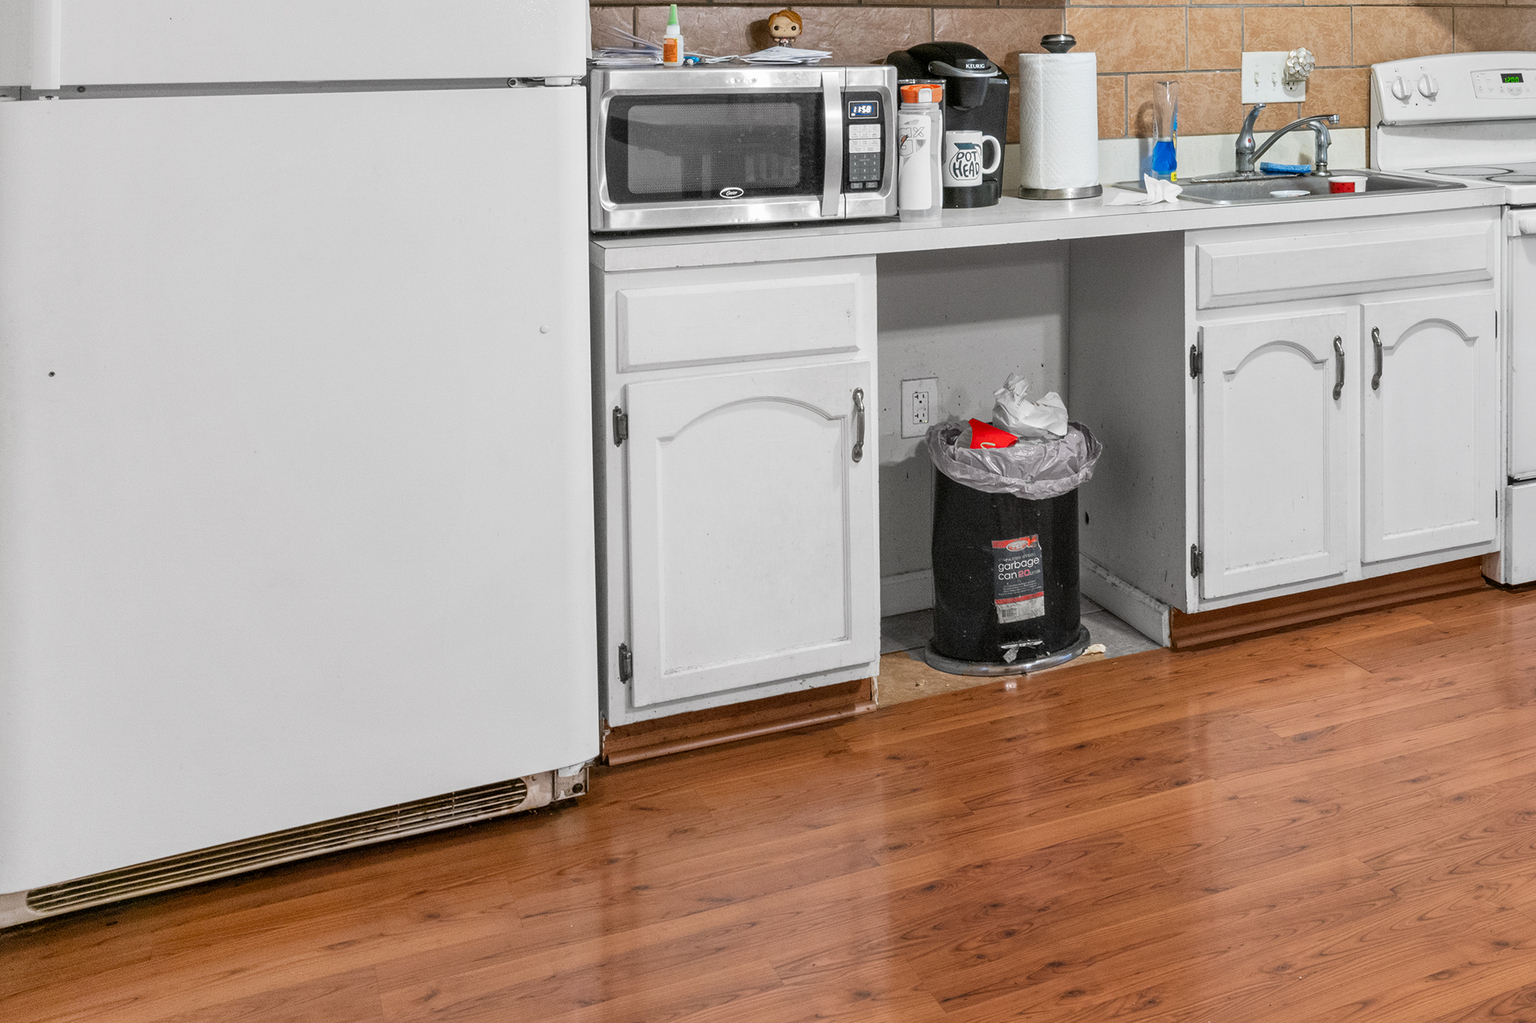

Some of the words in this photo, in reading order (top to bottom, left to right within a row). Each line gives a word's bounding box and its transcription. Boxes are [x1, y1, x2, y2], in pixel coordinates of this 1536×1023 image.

[955, 151, 978, 163] POT
[952, 160, 980, 178] HEAD
[997, 557, 1040, 573] garbage
[997, 571, 1018, 581] can
[1018, 569, 1031, 578] 20
